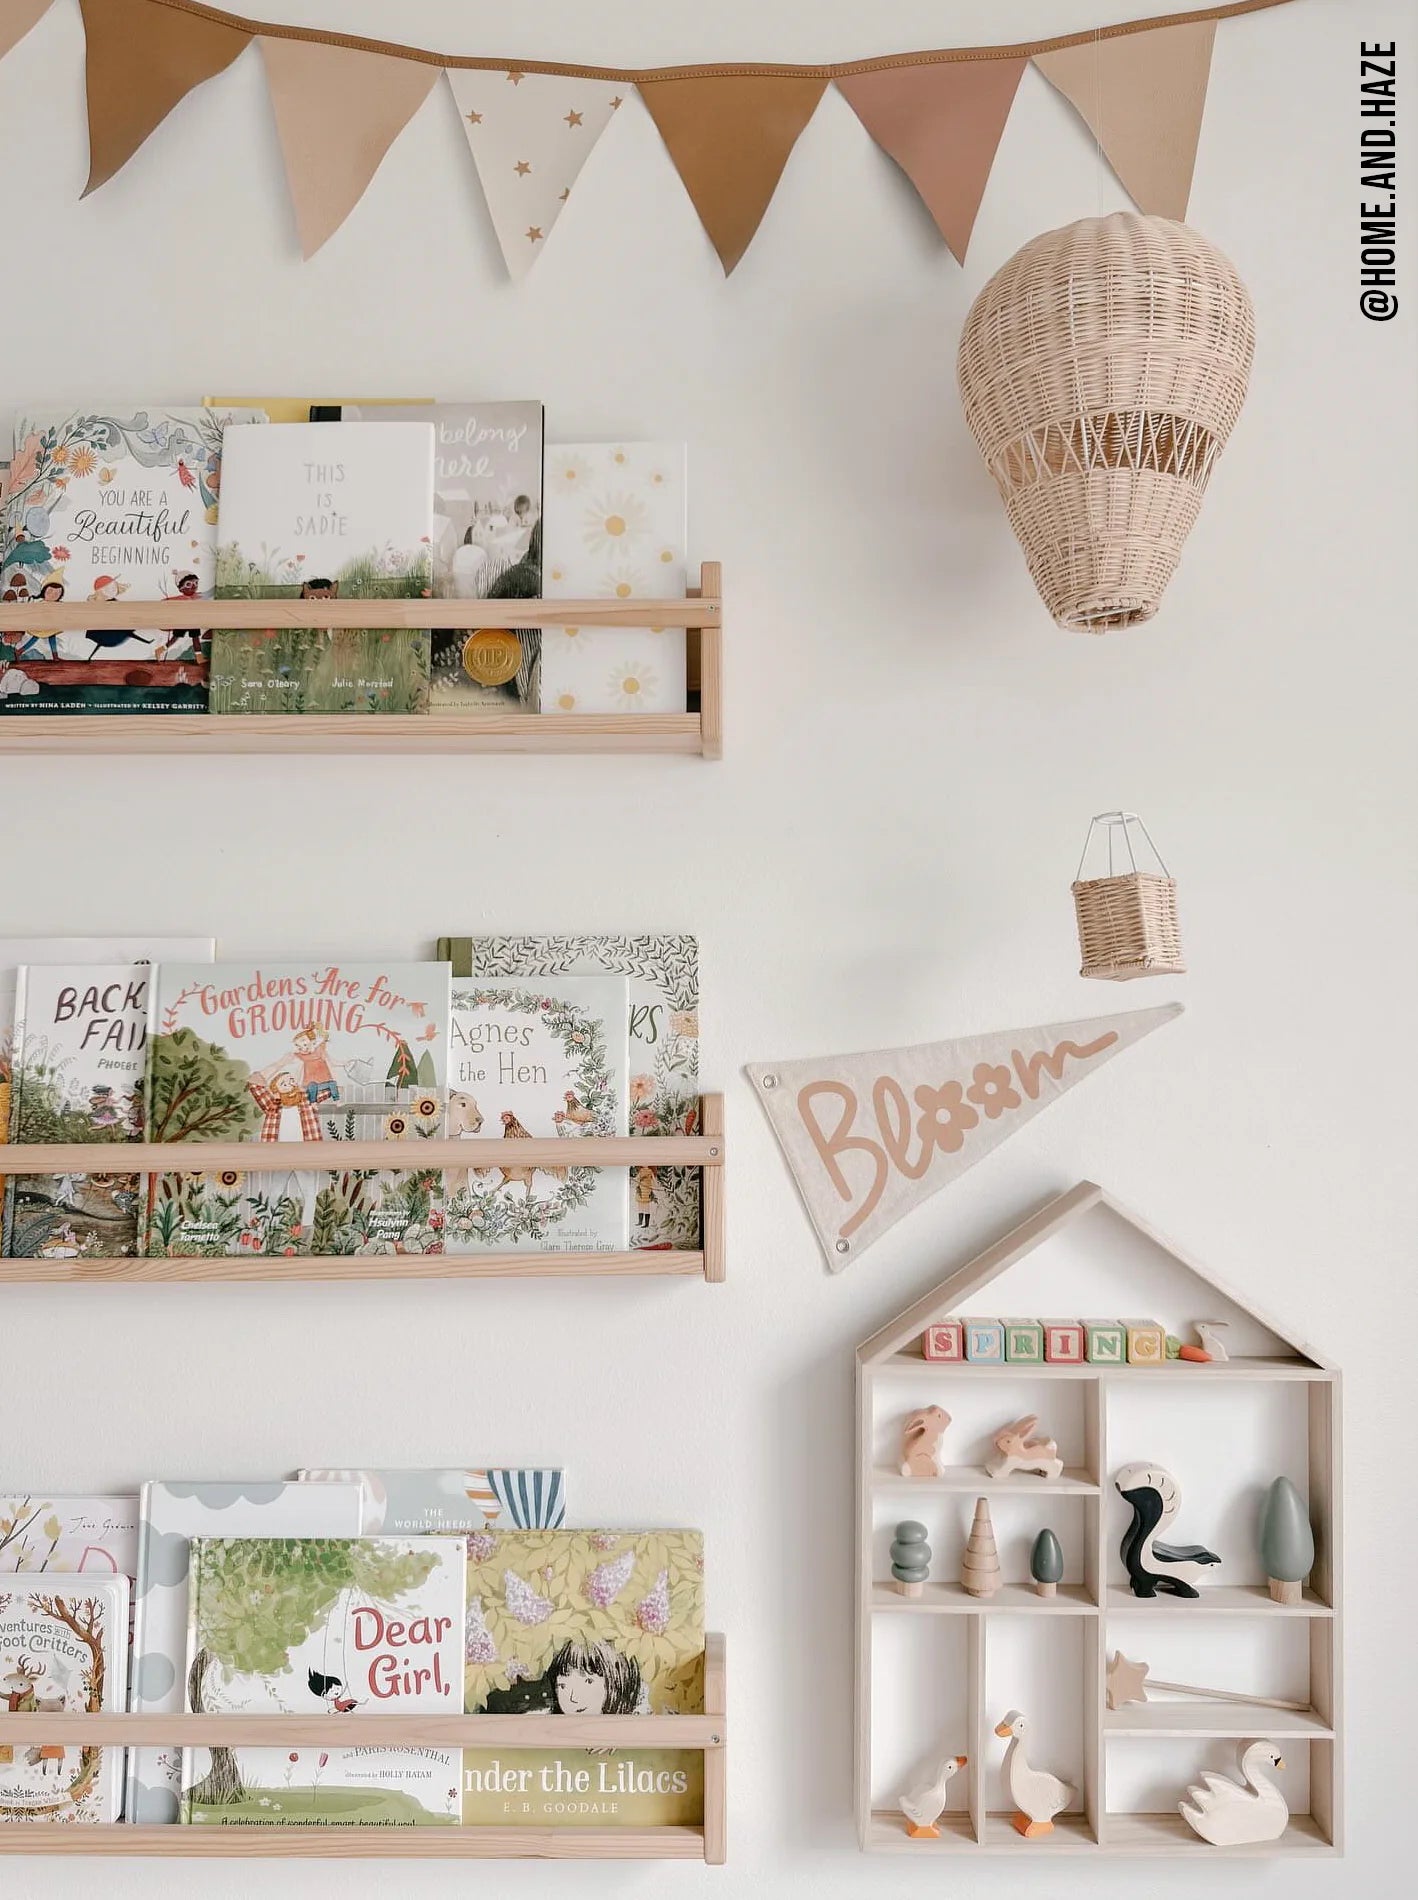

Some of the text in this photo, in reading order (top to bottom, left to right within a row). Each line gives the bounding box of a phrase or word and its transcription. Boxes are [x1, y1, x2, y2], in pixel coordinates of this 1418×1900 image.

[441, 417, 528, 453] belong
[303, 463, 345, 484] THIS
[99, 490, 168, 507] YOU ARE A
[317, 493, 332, 508] IS
[67, 508, 190, 542] Beautiful
[294, 511, 348, 536] SADIE
[91, 546, 170, 565] BEGINNING
[54, 981, 148, 1023] BACK
[200, 966, 406, 1015] Gardens Are for
[228, 998, 366, 1038] GROWING
[450, 1016, 534, 1052] Agnes
[98, 1058, 138, 1071] PHOEBE
[459, 1052, 548, 1084] the Hen
[798, 1030, 1119, 1239] Bloom
[376, 1229, 401, 1240] Pang
[394, 1519, 473, 1530] WORLD NEEDS
[424, 1508, 443, 1517] THE
[351, 1606, 452, 1651] Dear
[29, 1634, 88, 1664] Critters
[368, 1652, 451, 1699] Girl,
[379, 1769, 404, 1779] HOLLY
[539, 1760, 590, 1793] the
[598, 1761, 689, 1794] Lilacs
[221, 1816, 228, 1826] A
[504, 1803, 619, 1814] E. B. GOODALE
